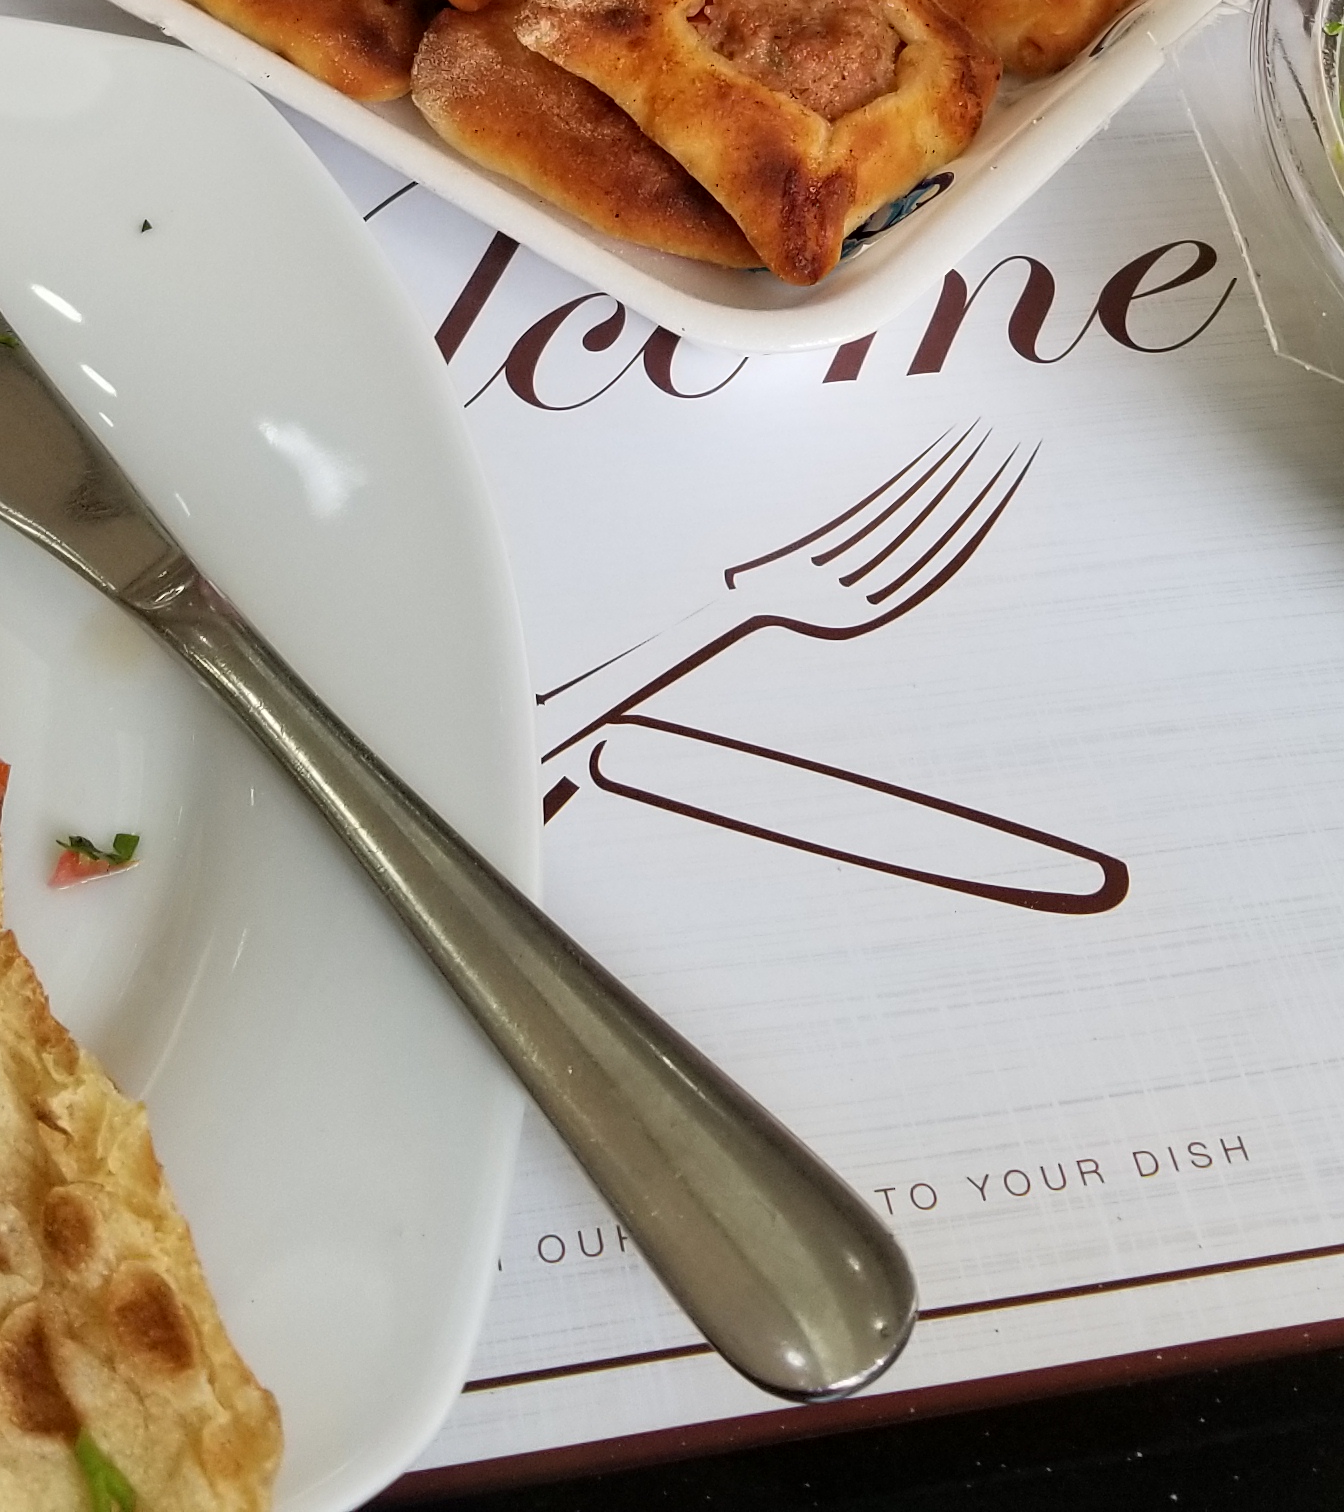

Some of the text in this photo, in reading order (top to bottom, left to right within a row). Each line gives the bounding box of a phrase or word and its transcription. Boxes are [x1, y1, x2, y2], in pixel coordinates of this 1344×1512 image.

[874, 1182, 938, 1216] TO
[966, 1158, 1105, 1202] YOUR
[1132, 1135, 1250, 1179] DISH
